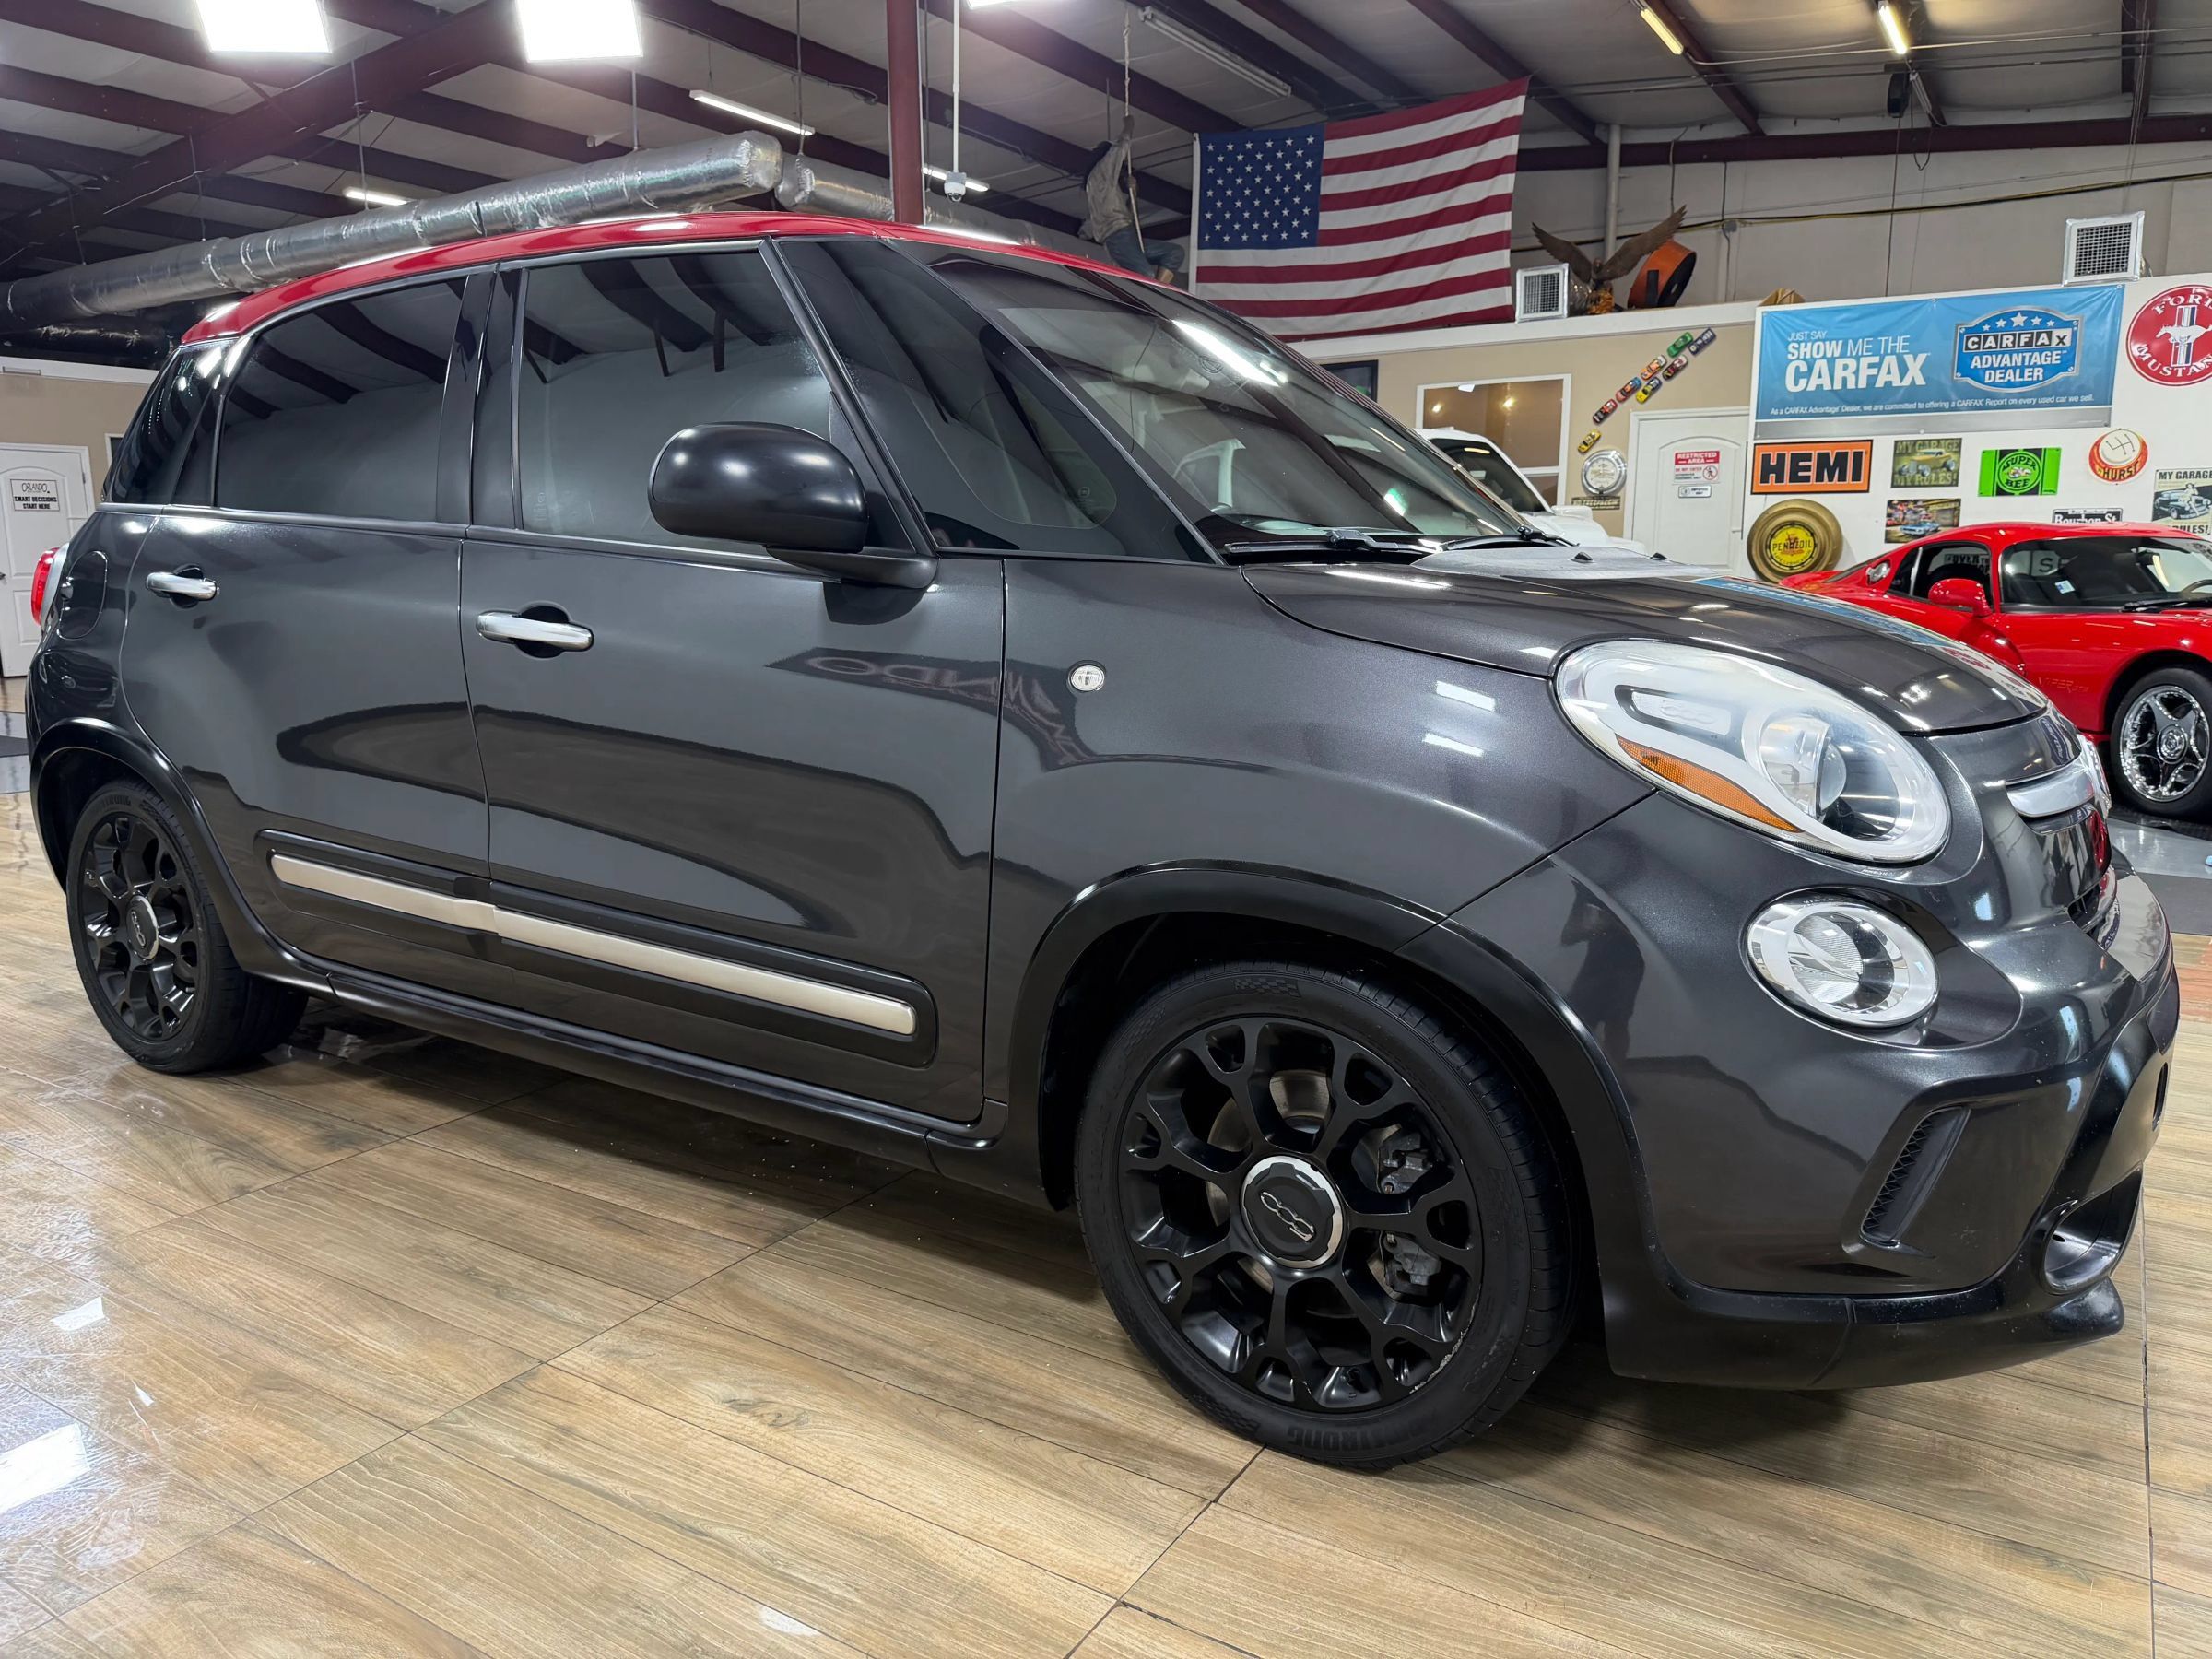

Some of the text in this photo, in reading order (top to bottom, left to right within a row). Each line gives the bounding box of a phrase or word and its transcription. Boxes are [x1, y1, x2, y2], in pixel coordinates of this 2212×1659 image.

[1788, 330, 1827, 342] JUST SAY
[1966, 333, 2067, 350] CARFAX
[1787, 335, 1911, 360] SHOW ME THE
[1785, 353, 1927, 393] CARFAX
[1984, 368, 2044, 383] DEALER
[1985, 398, 2007, 407] Report
[2018, 397, 2037, 406] every
[2038, 396, 2054, 405] used
[1896, 440, 1960, 453] MY GARAGE
[1677, 452, 1717, 460] RESTRICTED
[2002, 455, 2037, 471] SUPER
[1759, 450, 1865, 485] HEMI
[2102, 461, 2138, 480] HURST
[2005, 478, 2030, 488] BEE
[2159, 471, 2173, 480] MY
